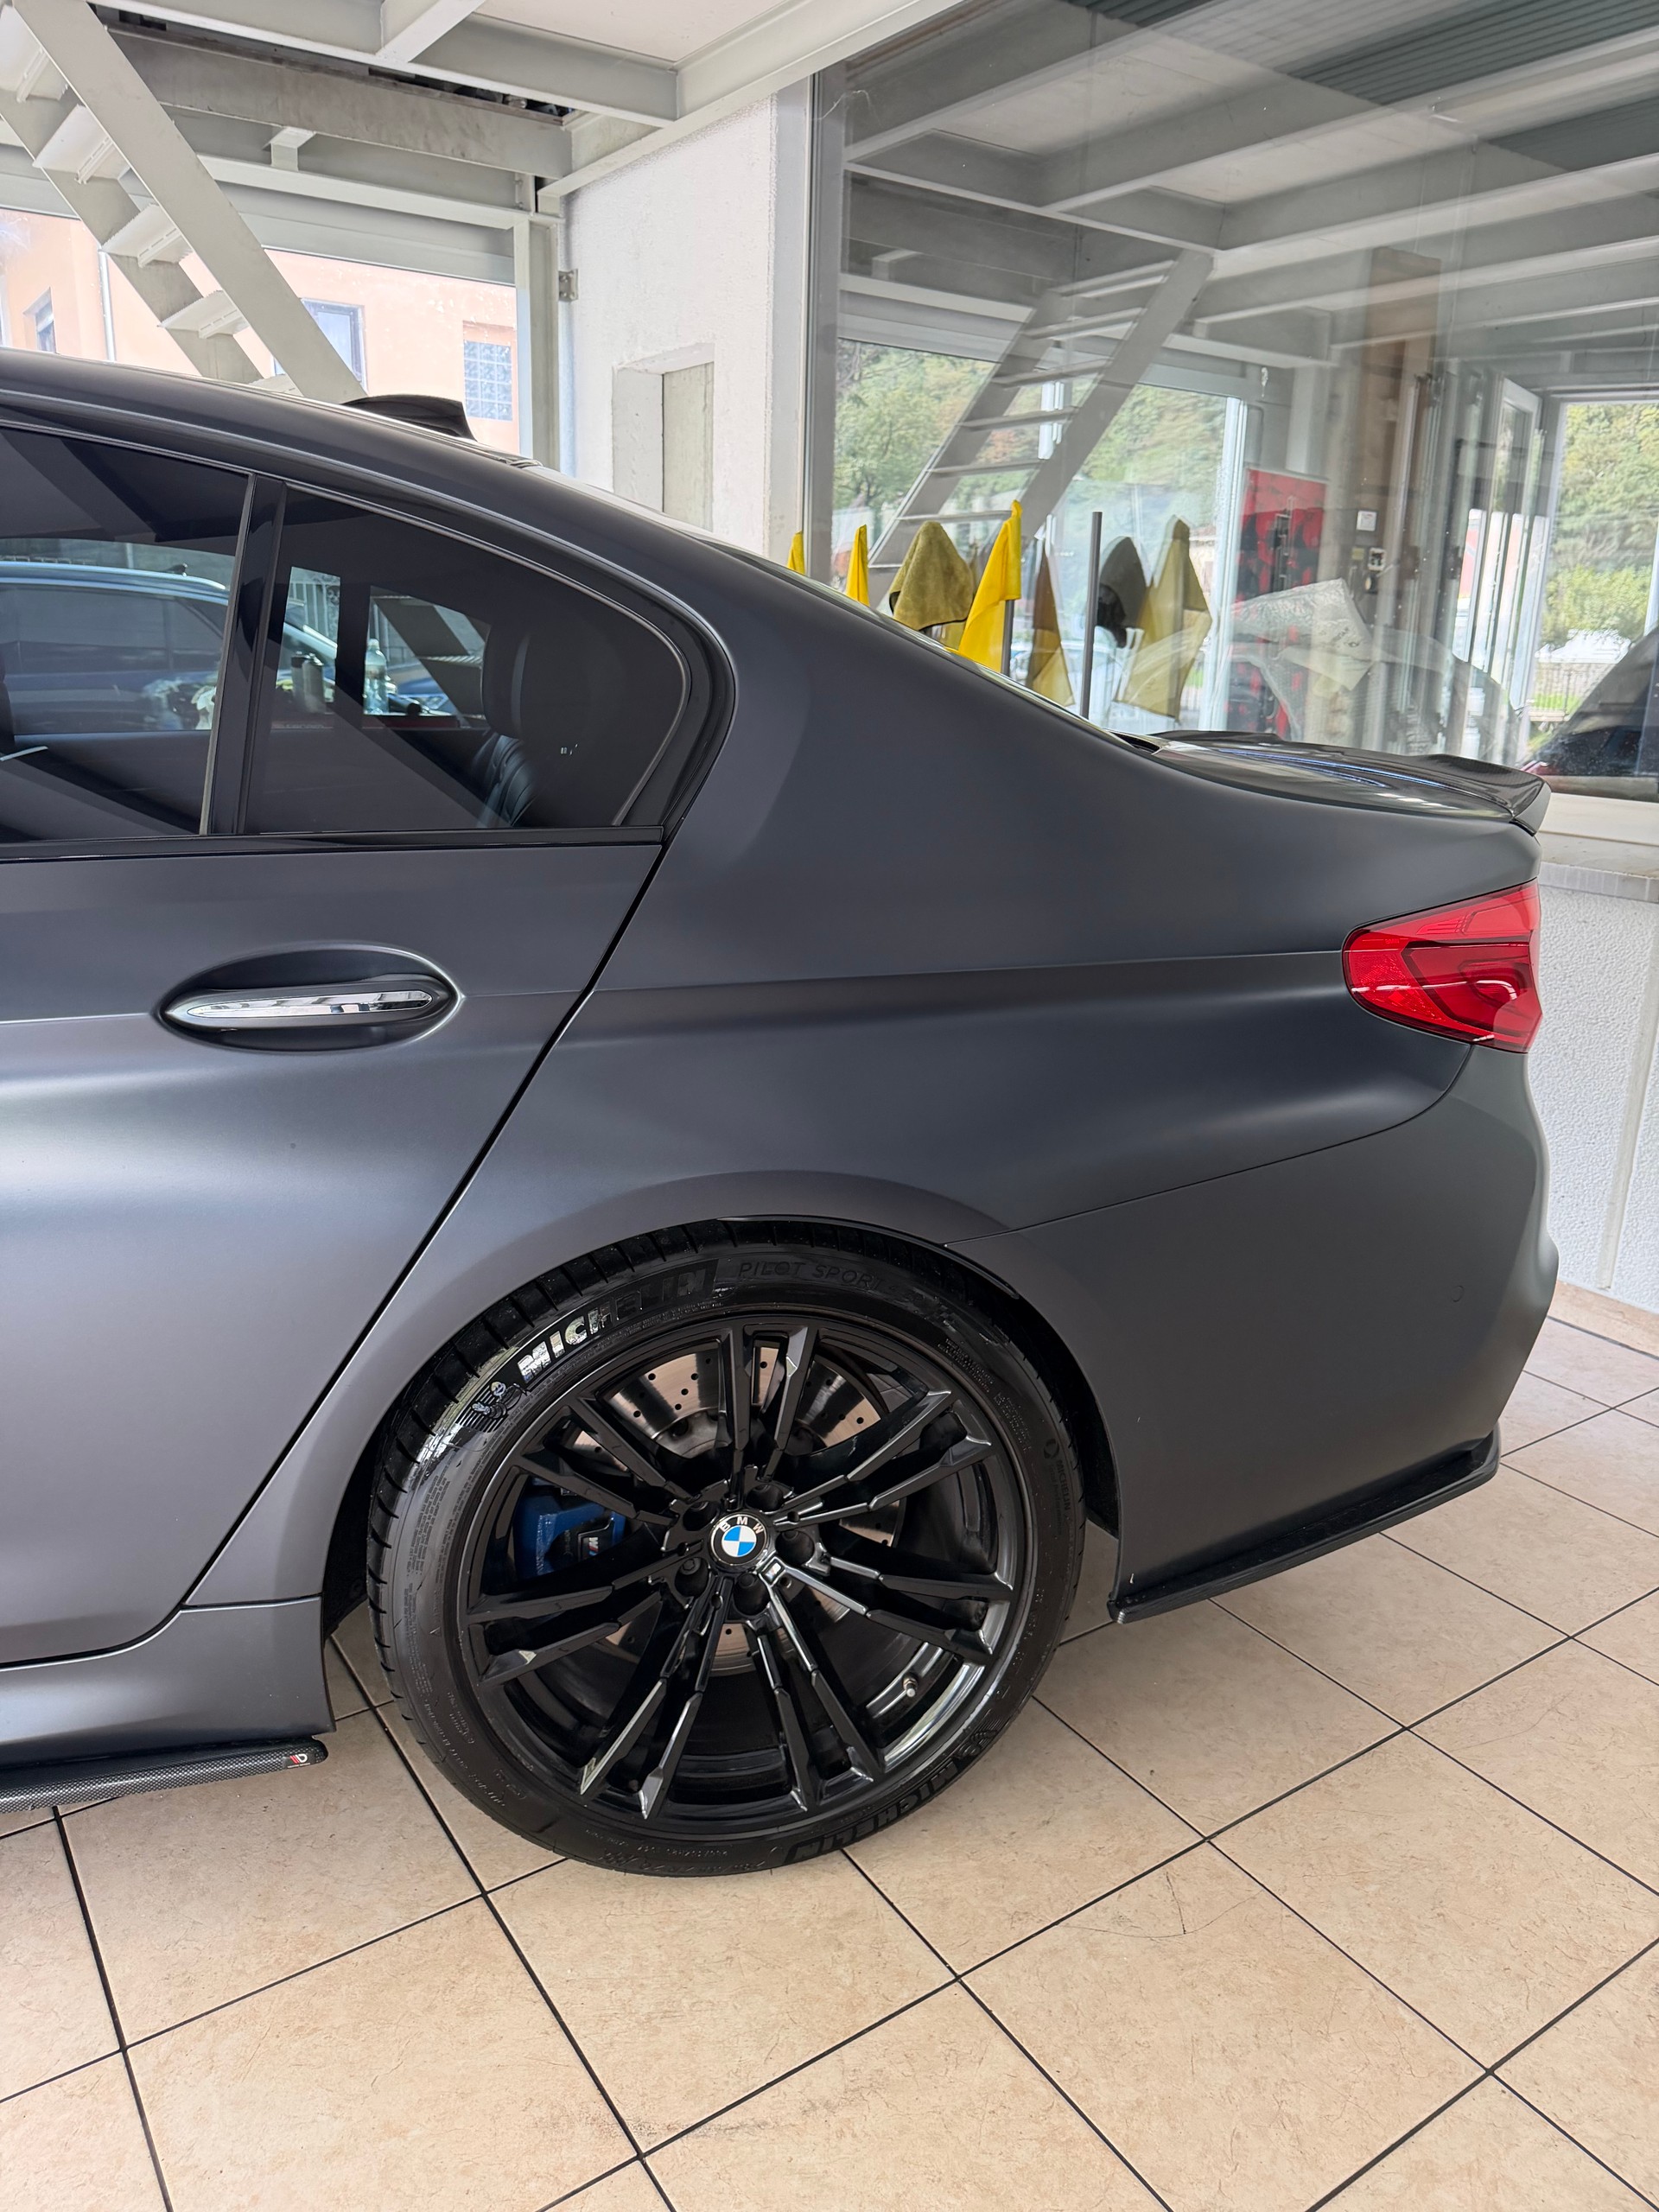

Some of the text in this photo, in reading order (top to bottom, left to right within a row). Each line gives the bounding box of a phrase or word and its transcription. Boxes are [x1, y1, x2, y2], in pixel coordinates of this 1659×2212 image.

[739, 1261, 882, 1290] PILOT SPORT
[518, 1268, 706, 1382] MICHELIN
[719, 1516, 764, 1534] BMW
[798, 1759, 958, 1860] MICHELIN
